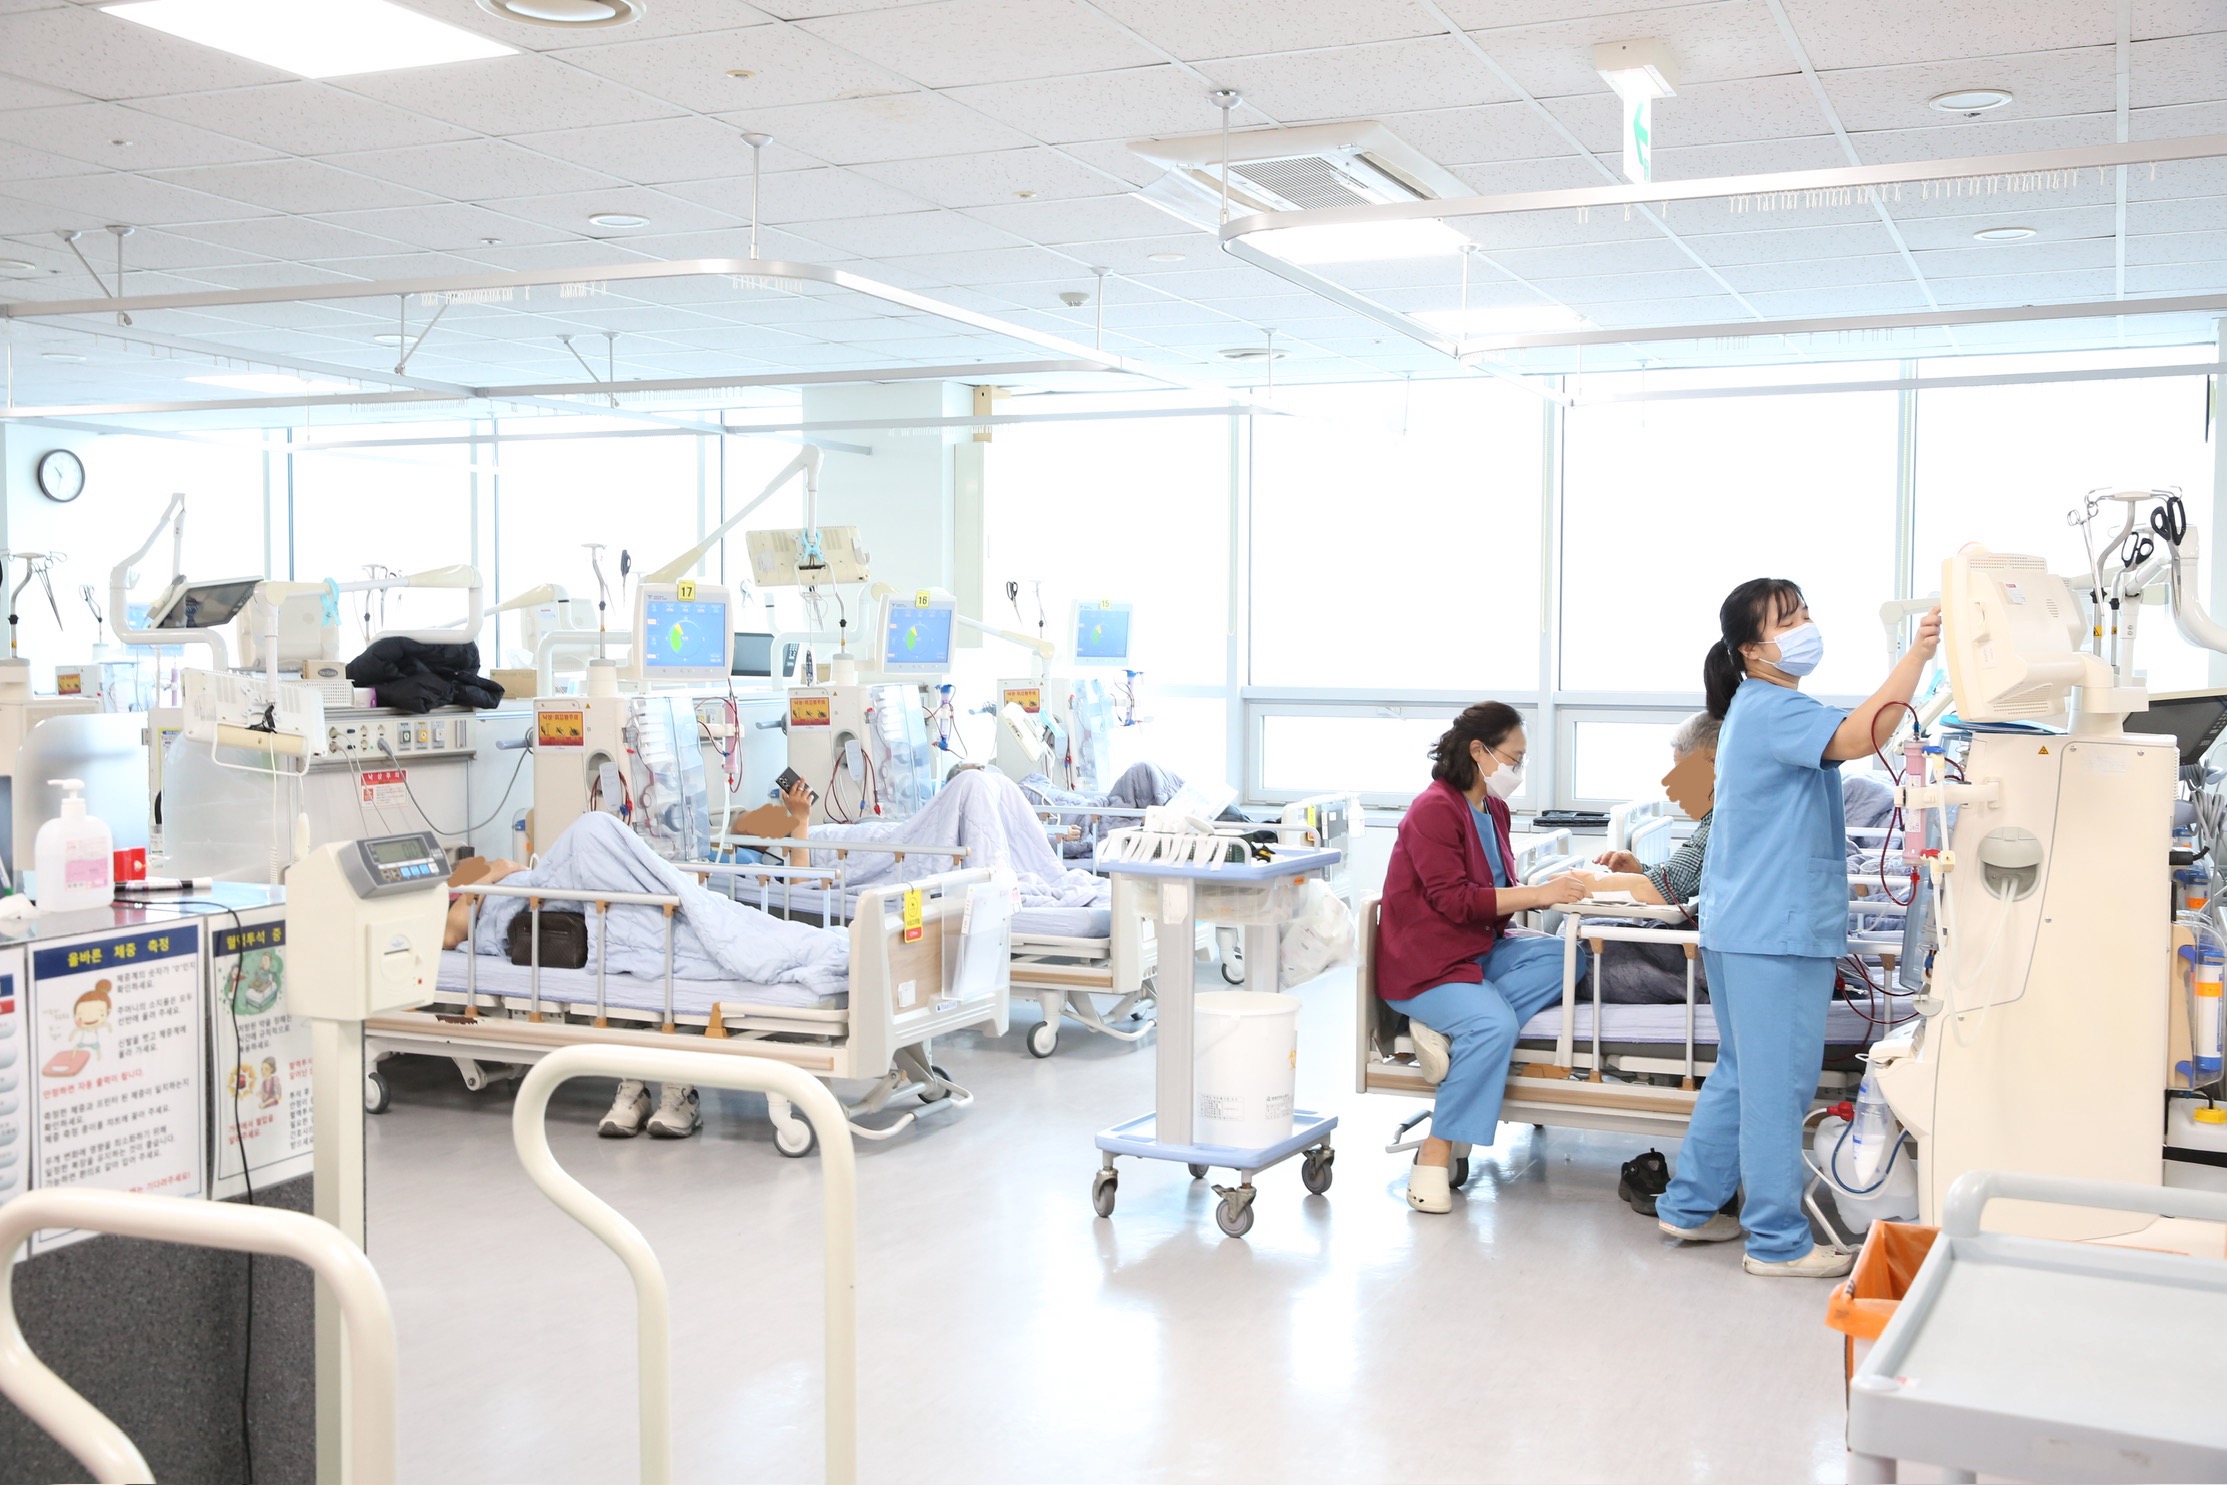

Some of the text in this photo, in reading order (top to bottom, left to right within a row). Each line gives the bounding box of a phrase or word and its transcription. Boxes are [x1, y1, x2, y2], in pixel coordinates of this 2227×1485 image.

[682, 586, 692, 598] 17
[918, 596, 927, 605] 16
[1102, 600, 1110, 608] 15
[272, 928, 282, 942] 중
[68, 936, 170, 968] 올바른 체중 측정
[117, 971, 145, 982] 체중계의
[149, 967, 169, 977] 숫자가
[118, 994, 191, 1014] 주머니의 소지품은 모두
[119, 1014, 139, 1026] 선반에
[119, 1025, 186, 1048] 신발을 벗고 체중계에
[79, 1080, 92, 1089] 자동
[96, 1075, 117, 1087] 출력이
[44, 1109, 66, 1119] 측정한
[71, 1103, 93, 1114] 체중과
[132, 1088, 151, 1099] 체중이
[155, 1078, 189, 1094] 일치하는지
[45, 1132, 59, 1143] 체중
[64, 1128, 78, 1138] 측정
[82, 1121, 103, 1134] 종이를
[107, 1115, 128, 1125] 차트에
[230, 1119, 253, 1132] 가에서
[46, 1155, 60, 1165] 무게
[64, 1148, 86, 1161] 변화에
[114, 1129, 150, 1146] 최소화하기
[154, 1126, 166, 1134] 위해
[46, 1164, 68, 1177] 일정한
[98, 1149, 125, 1162] 유지하는
[130, 1144, 142, 1154] 것이
[122, 1157, 135, 1166] 입어
